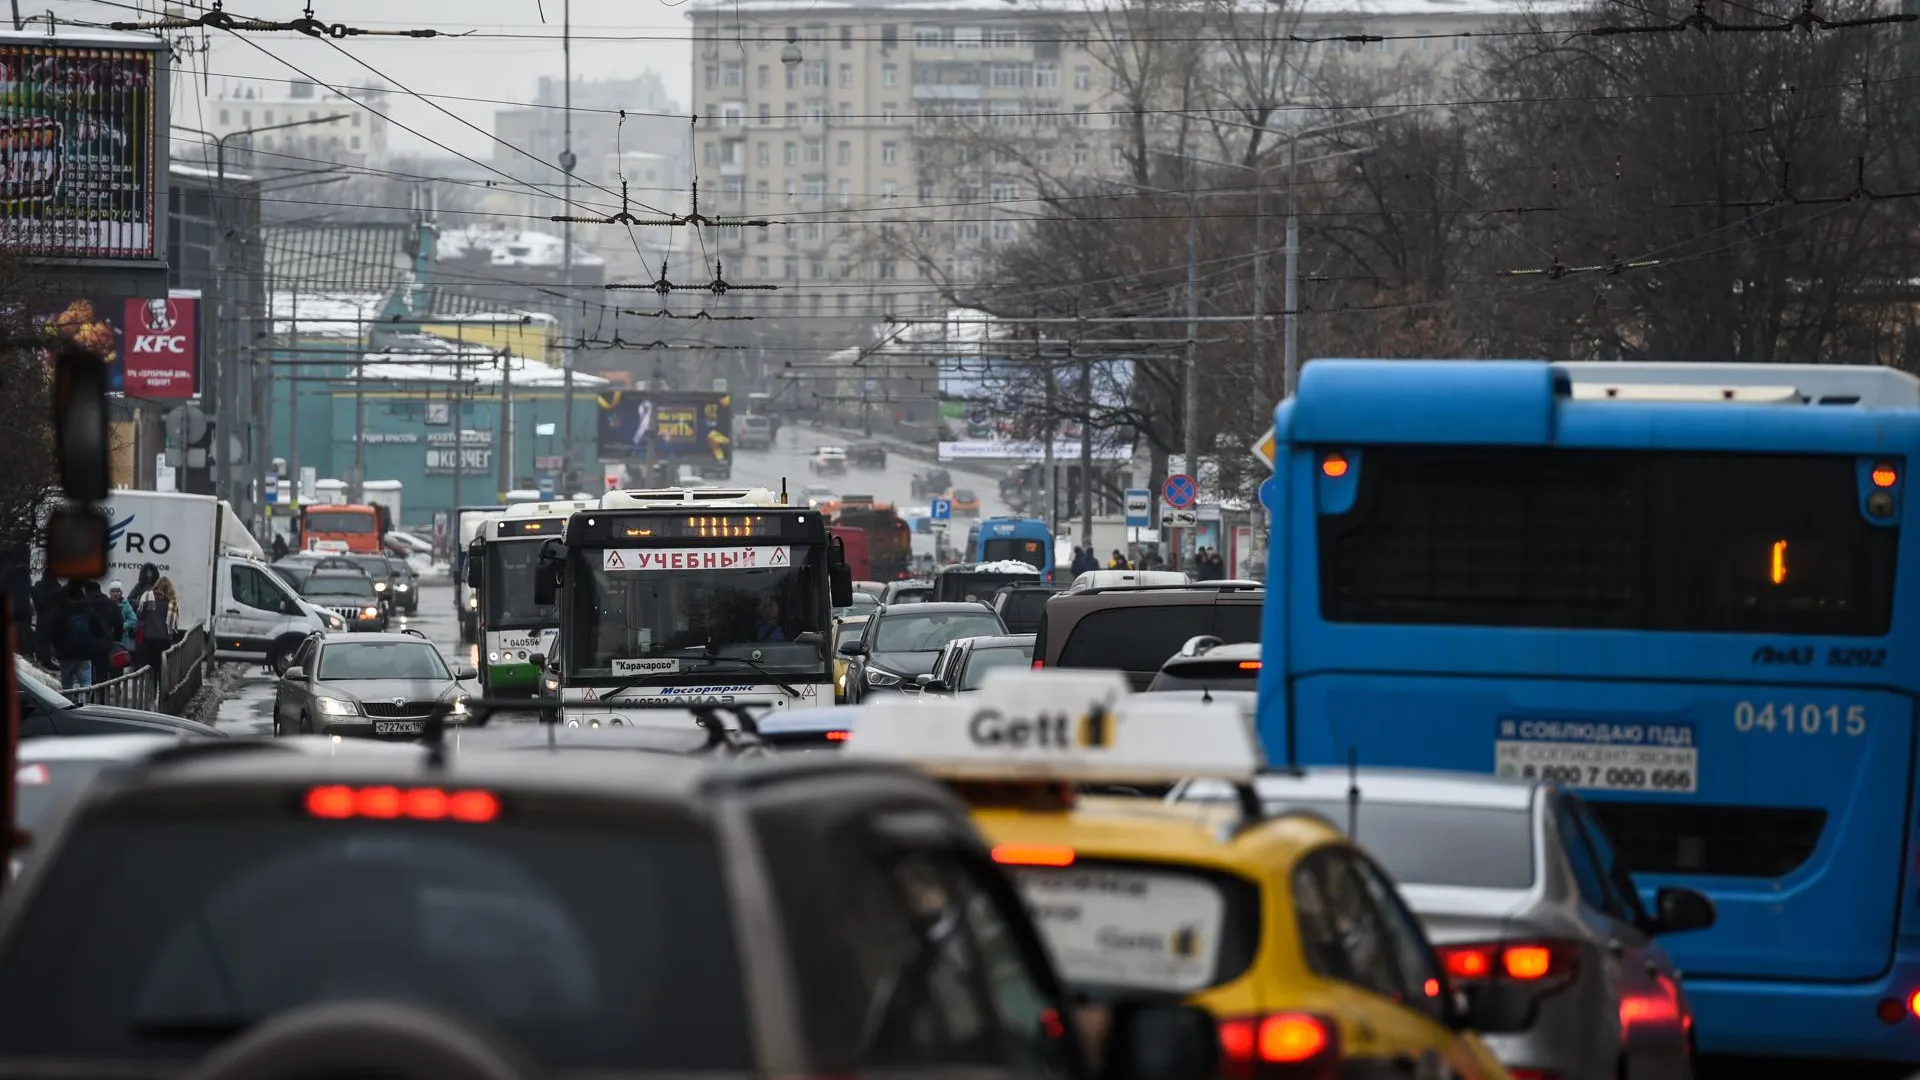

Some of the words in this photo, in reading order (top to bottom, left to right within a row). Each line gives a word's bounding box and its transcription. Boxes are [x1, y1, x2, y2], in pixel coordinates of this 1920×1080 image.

[133, 335, 186, 353] KFC
[119, 562, 170, 571] РЕСТОНОВ
[639, 548, 756, 568] УЧЕБНЫЙ
[615, 660, 676, 671] "Карачарово"
[660, 685, 754, 695] Мосгортранс
[969, 709, 1068, 747] Gett
[1734, 701, 1866, 736] 041015
[1501, 720, 1515, 736] Я
[1519, 721, 1643, 743] СОБЛЮДАЮ
[1649, 726, 1692, 745] ПДД
[1588, 766, 1601, 783] 7
[1605, 768, 1646, 786] 000
[1651, 769, 1691, 788] 666
